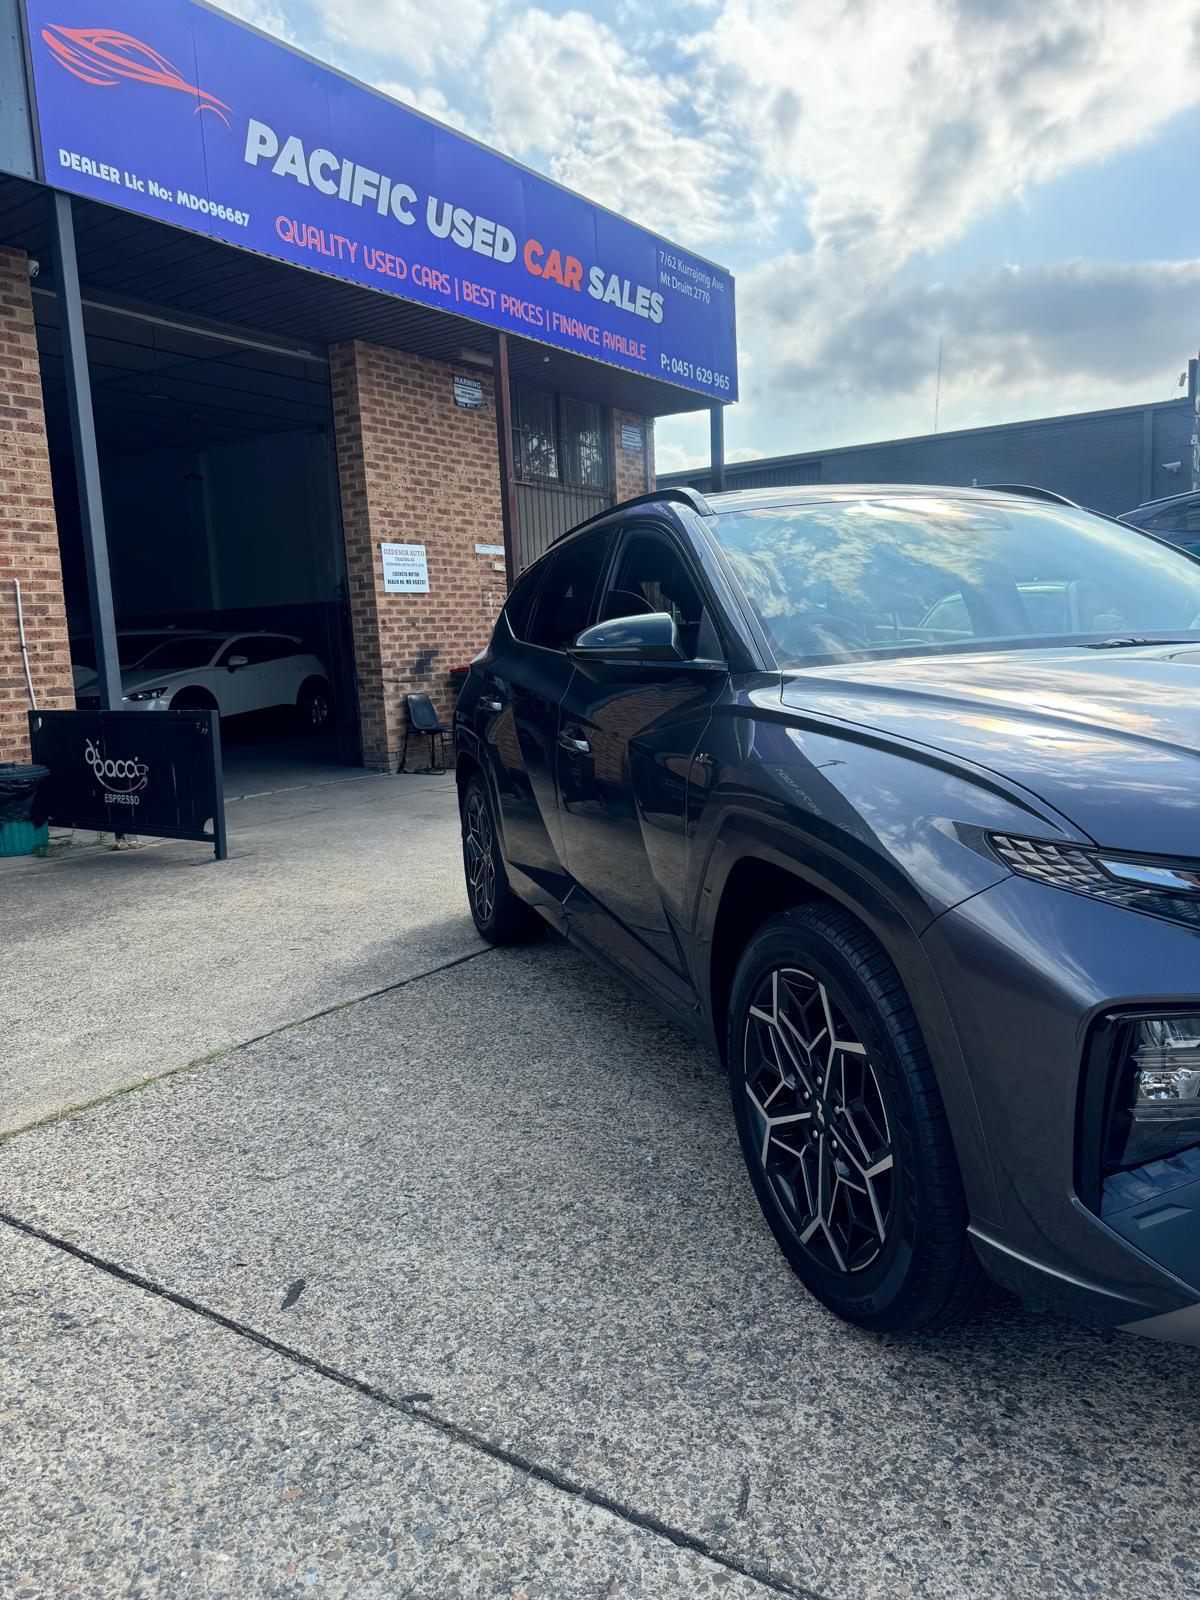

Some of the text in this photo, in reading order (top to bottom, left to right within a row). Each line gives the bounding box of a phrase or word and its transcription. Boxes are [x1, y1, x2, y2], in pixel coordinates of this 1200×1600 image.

[59, 148, 121, 185] DEALER
[124, 171, 145, 193] Lic
[148, 180, 173, 202] No:
[244, 118, 665, 324] PACIFIC USED CAR SALES
[275, 215, 357, 264] QUALITY
[363, 245, 407, 279] USED
[411, 264, 451, 295] CARS
[462, 280, 496, 309] BEST
[501, 293, 544, 326] PRICES
[552, 312, 600, 345] FINANCE
[602, 331, 647, 361] AVAILBLE
[659, 251, 724, 292] 7/62 Kurrajong Ave
[660, 271, 711, 304] Mt Druitt 2770
[453, 375, 482, 389] WARNING
[660, 352, 730, 390] P: 0451 629 965
[104, 793, 140, 805] ESPRESSO
